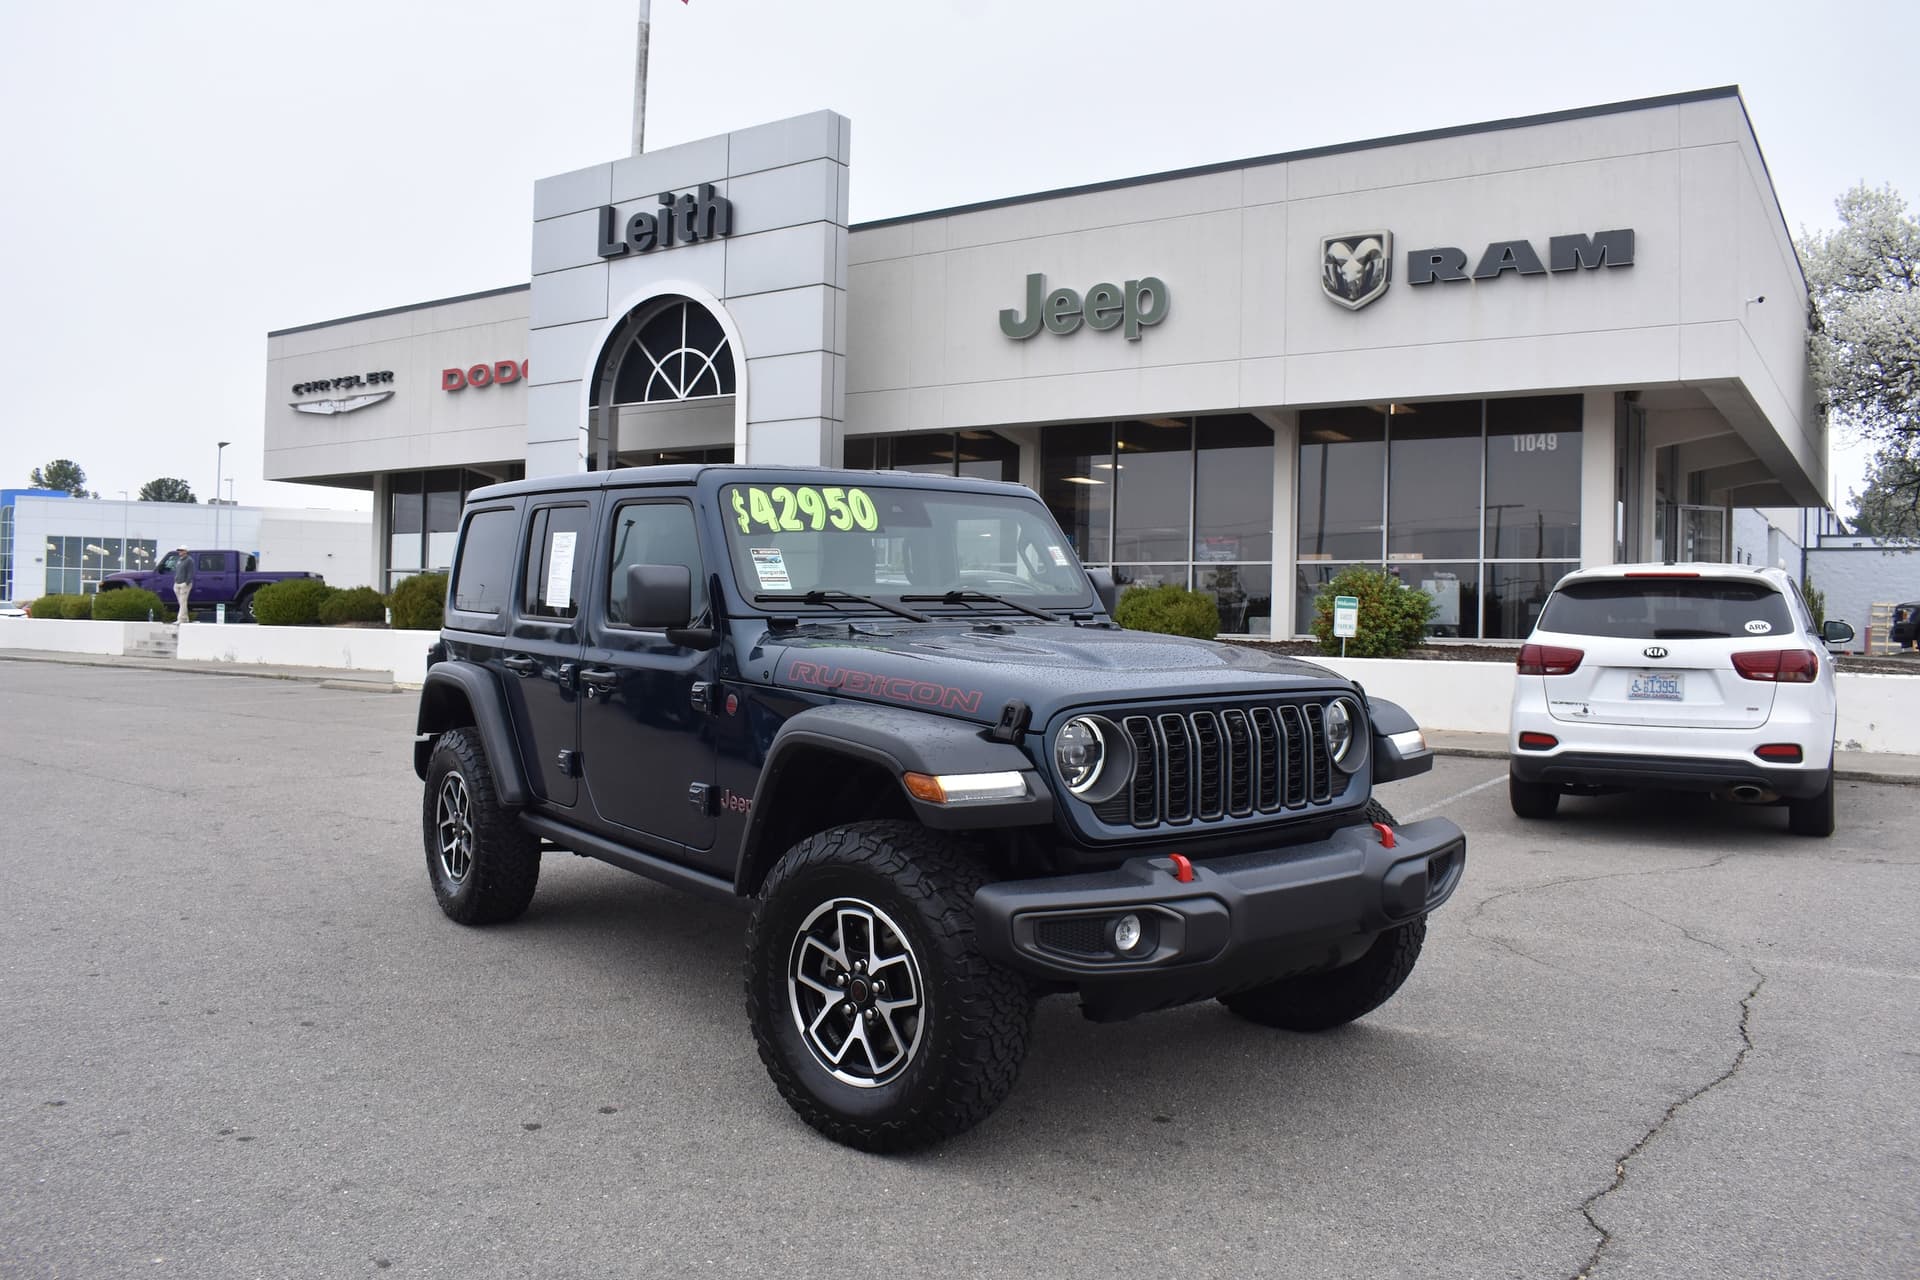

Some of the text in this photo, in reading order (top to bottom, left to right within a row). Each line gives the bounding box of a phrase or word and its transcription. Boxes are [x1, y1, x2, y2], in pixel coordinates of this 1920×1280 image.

[598, 183, 732, 258] Leith
[1408, 229, 1634, 285] RAM
[999, 273, 1170, 341] Jeep
[292, 370, 394, 396] CHRYSLER
[1513, 433, 1558, 452] 11049
[732, 486, 878, 533] $42950
[788, 661, 983, 713] RUBICON
